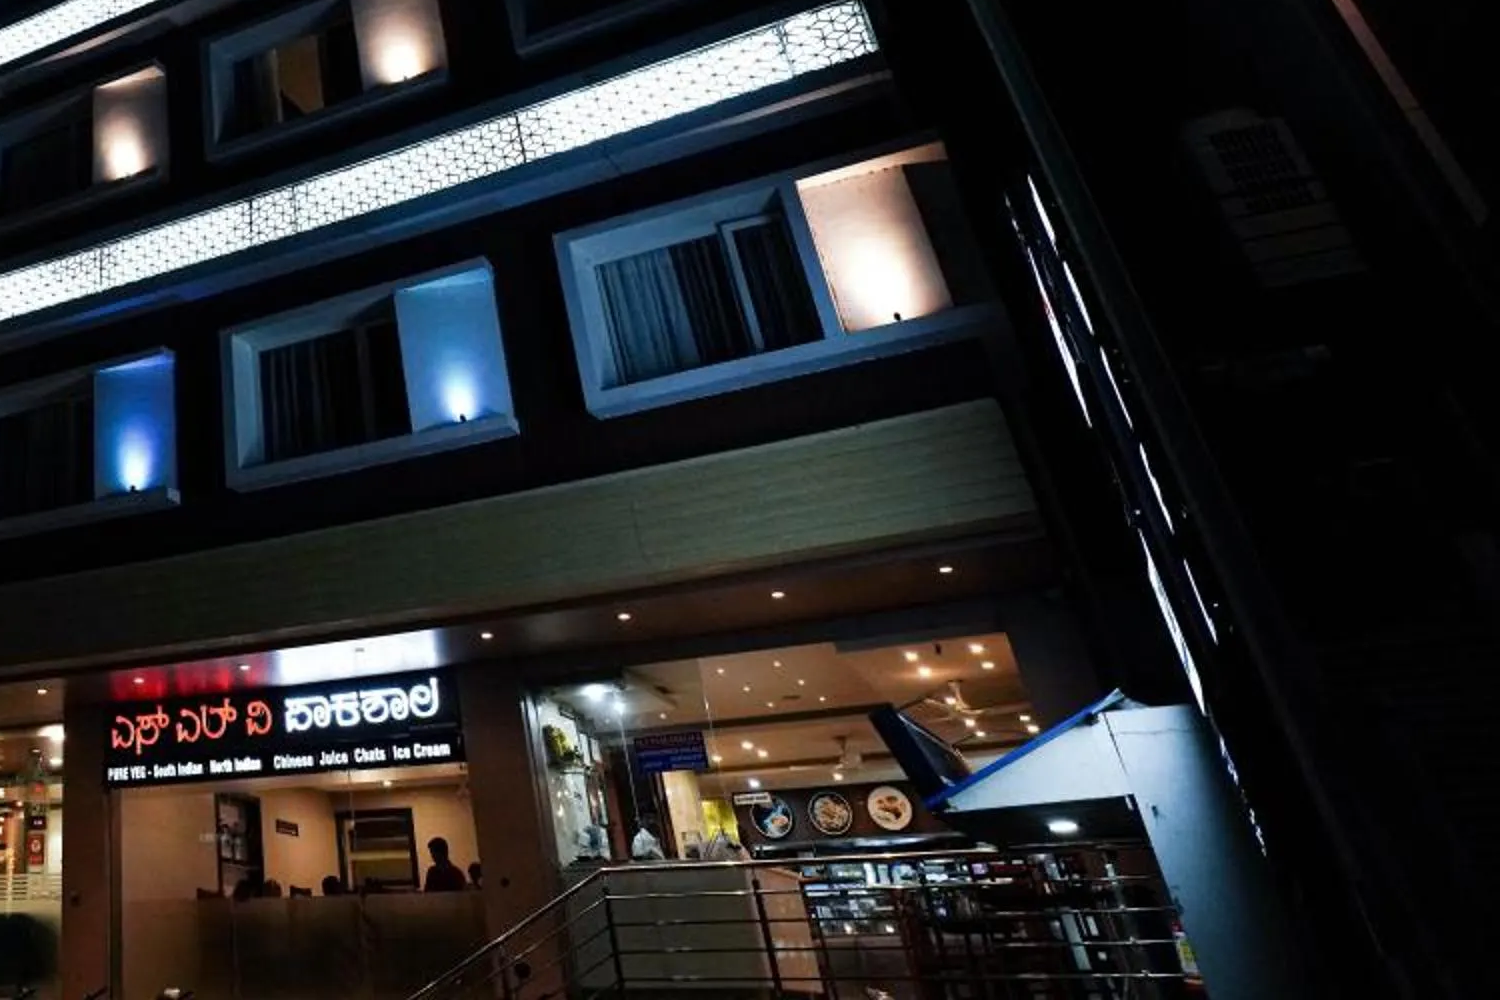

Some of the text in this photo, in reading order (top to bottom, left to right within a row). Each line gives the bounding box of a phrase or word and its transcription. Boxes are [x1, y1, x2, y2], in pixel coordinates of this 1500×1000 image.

[111, 704, 170, 756] ಎಸ್
[176, 697, 238, 743] ಎಲ್
[245, 700, 273, 736] ವಿ
[107, 767, 129, 781] PURE
[178, 761, 204, 777] Indian
[273, 754, 314, 769] Chinese
[319, 750, 349, 767] Juice
[354, 747, 387, 763] Chats
[393, 744, 411, 760] Ice
[413, 742, 451, 759] Cream
